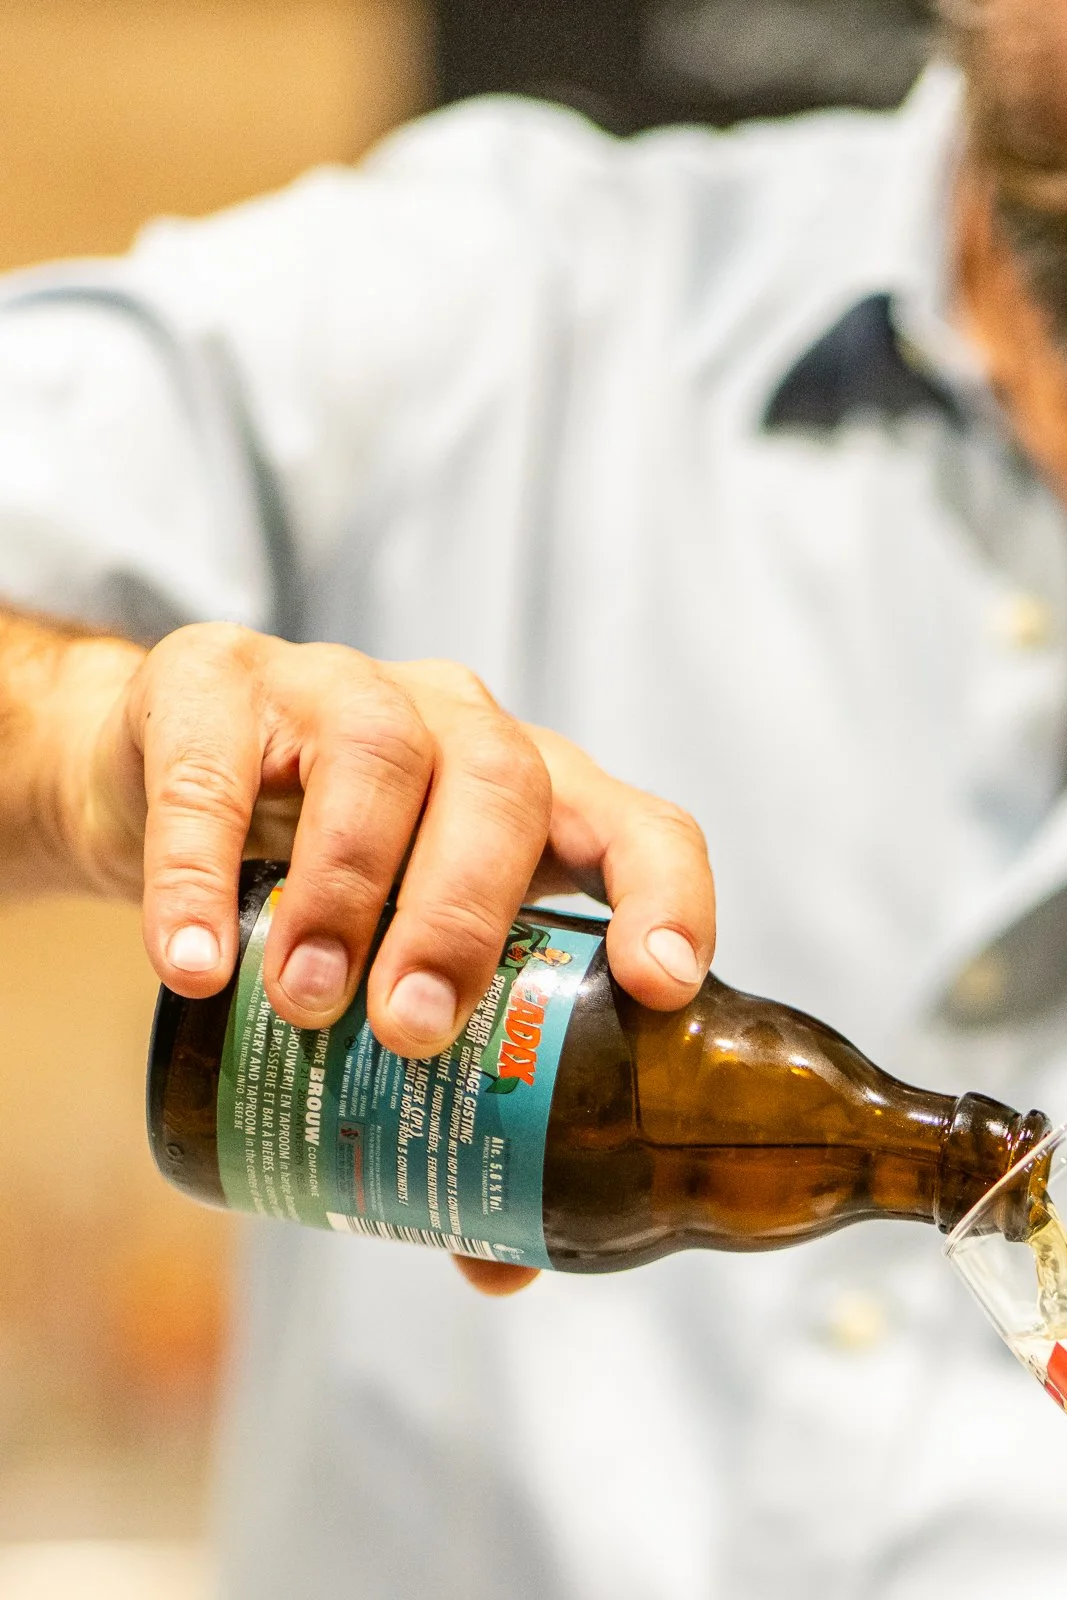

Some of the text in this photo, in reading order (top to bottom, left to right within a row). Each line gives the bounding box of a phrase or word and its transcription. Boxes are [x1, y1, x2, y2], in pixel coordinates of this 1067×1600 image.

[251, 1001, 271, 1054] BREWERY
[248, 1057, 261, 1081] AND
[264, 1029, 284, 1089] BRASSERIE
[280, 1026, 301, 1091] BROUWERIJ
[405, 1059, 417, 1082] MALT
[457, 1046, 470, 1078] GEHOPT
[459, 974, 505, 1144] SPECIAALBIER VAN LAGE GISTING
[236, 1074, 246, 1094] INFO
[404, 1084, 413, 1092] &
[413, 1067, 429, 1104] LAGER
[244, 1085, 258, 1135] TAPROOM
[263, 1092, 274, 1105] ET
[280, 1094, 291, 1108] EN
[305, 1068, 325, 1146] BROUW
[399, 1093, 413, 1119] HOPS
[262, 1107, 273, 1128] BAR
[449, 1088, 463, 1138] DRY-HOPPED
[245, 1137, 256, 1146] in
[278, 1112, 291, 1159] TAPROOM
[398, 1121, 409, 1145] FROM
[245, 1149, 257, 1162] the
[448, 1139, 458, 1156] MET
[280, 1162, 290, 1170] in
[447, 1157, 457, 1174] HOP
[426, 1156, 437, 1209] FERMENTATION
[447, 1175, 457, 1187] UIT
